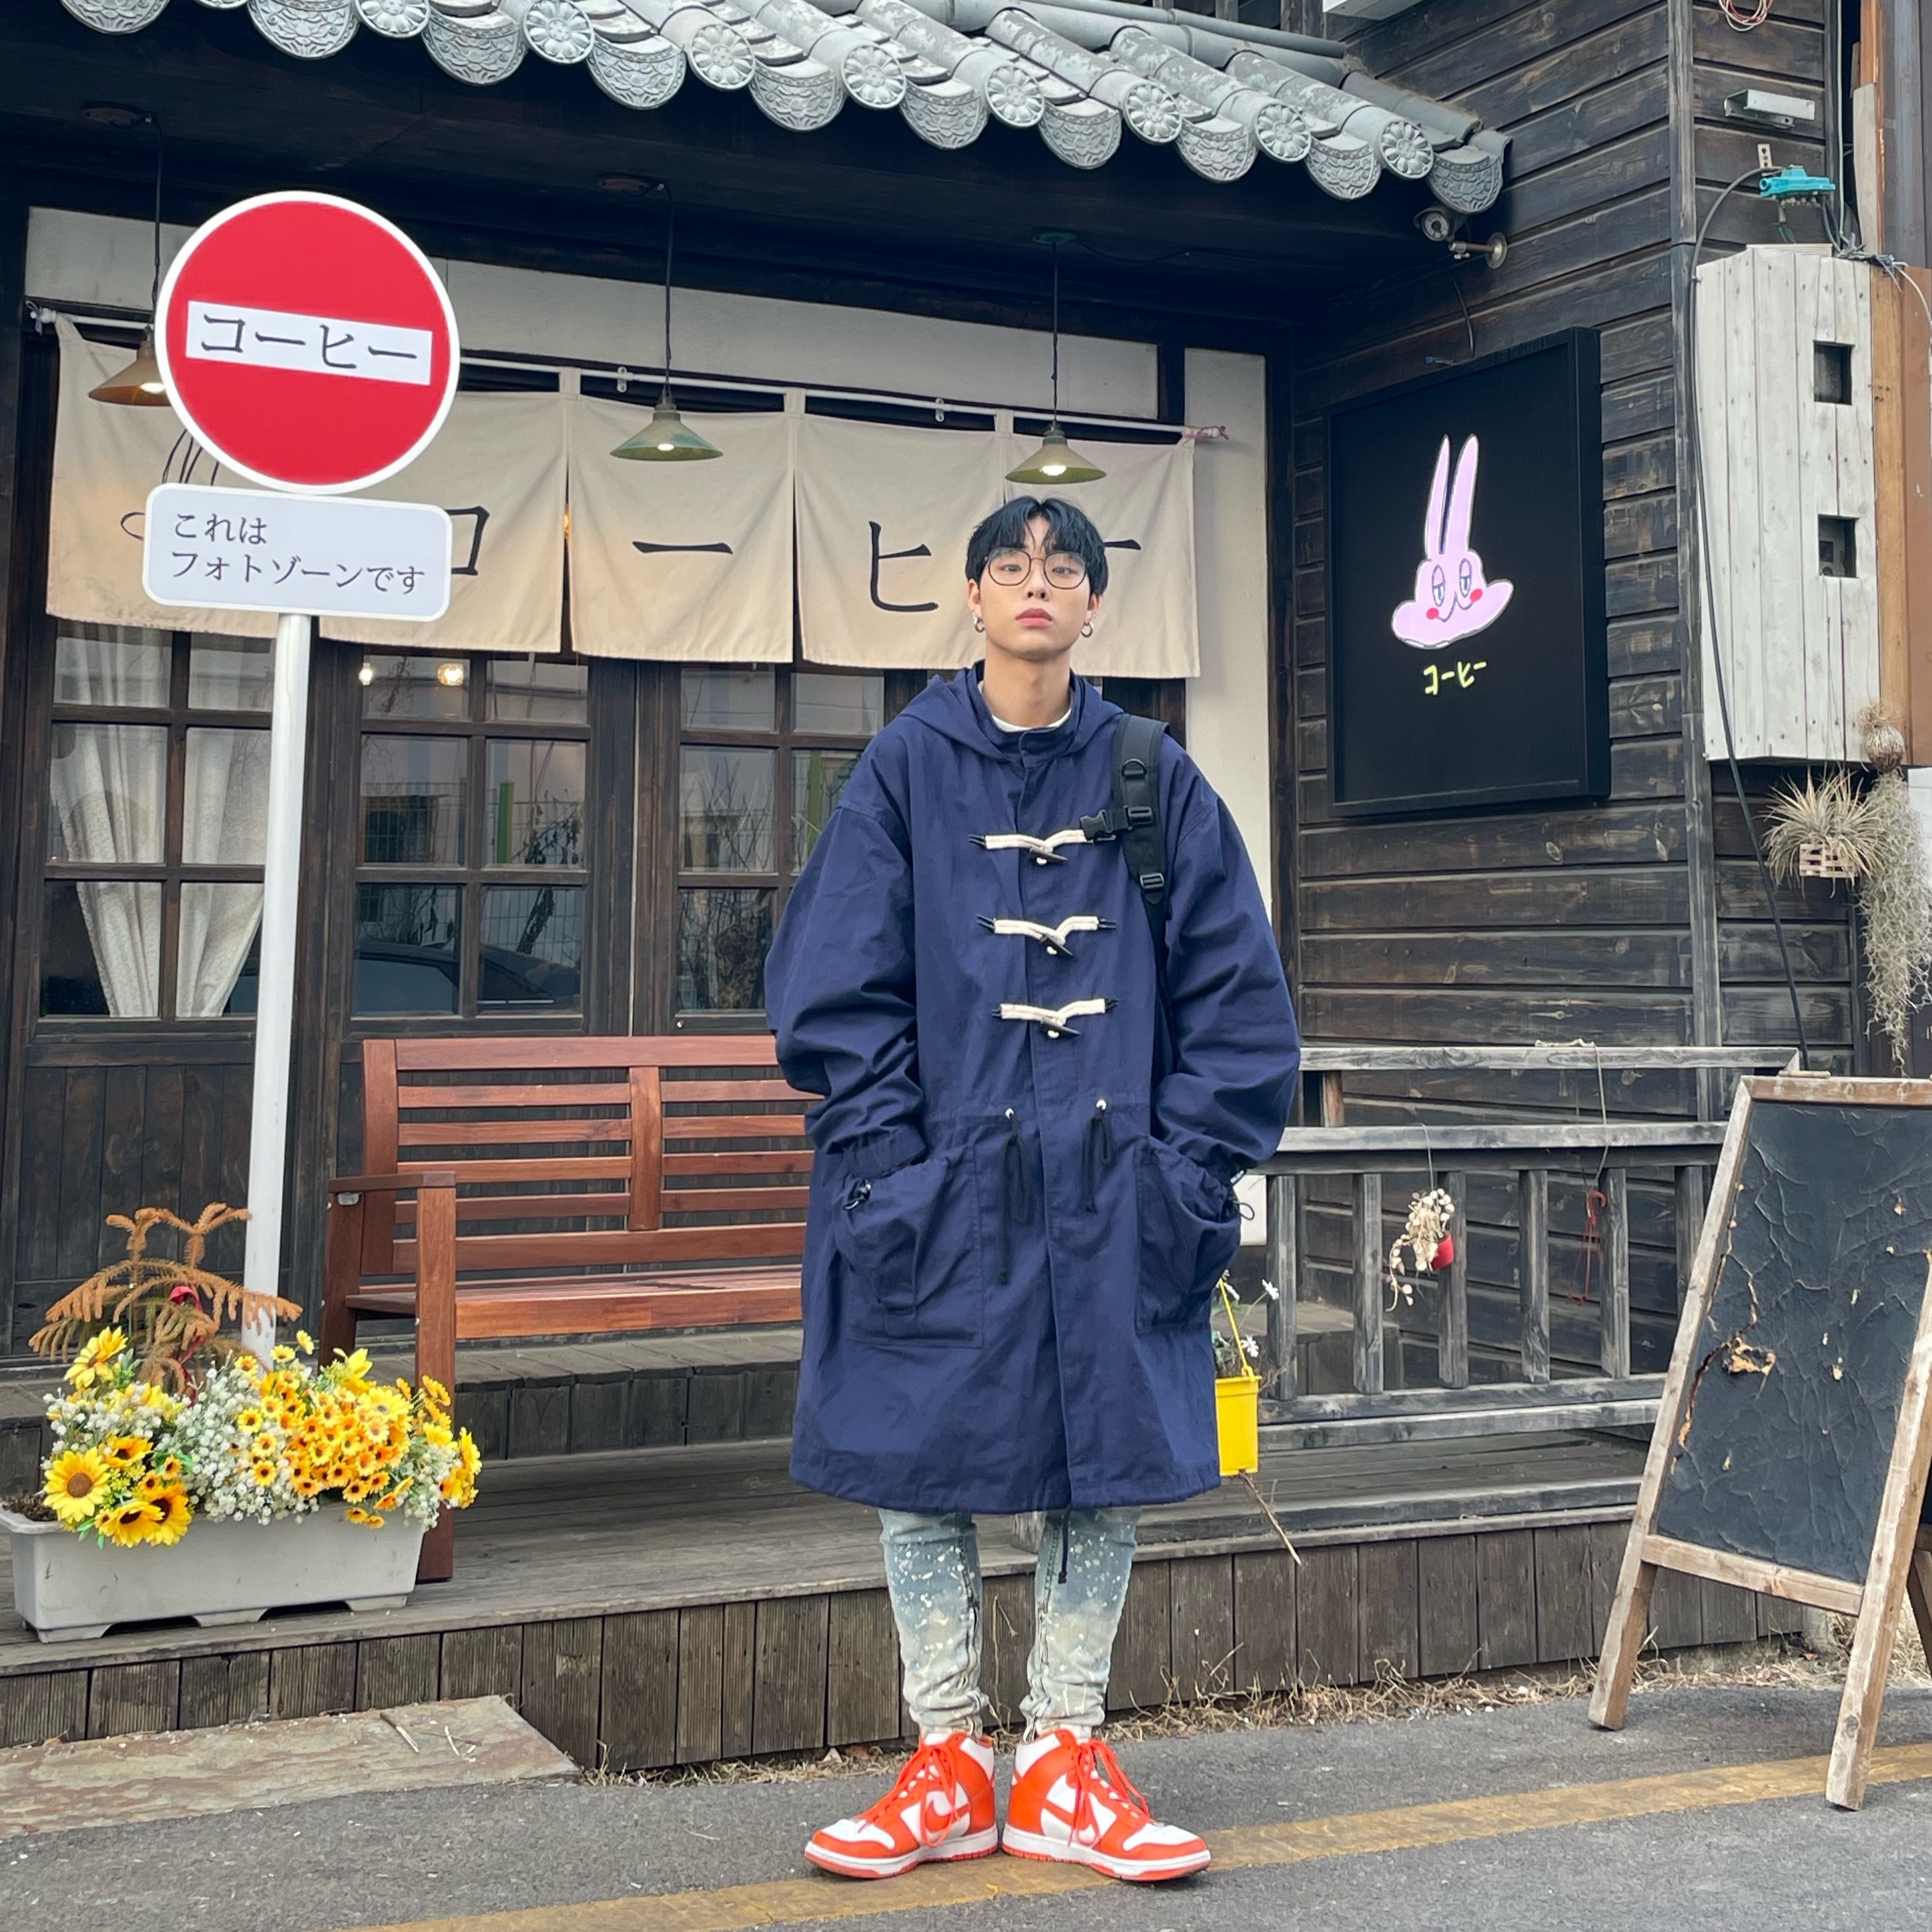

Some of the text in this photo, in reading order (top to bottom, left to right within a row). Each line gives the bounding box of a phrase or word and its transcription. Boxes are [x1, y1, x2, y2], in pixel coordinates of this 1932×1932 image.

[201, 314, 417, 369] コーヒー
[174, 513, 267, 545] これは
[171, 552, 425, 594] フォトゾーンです
[1423, 661, 1487, 696] コーヒー
